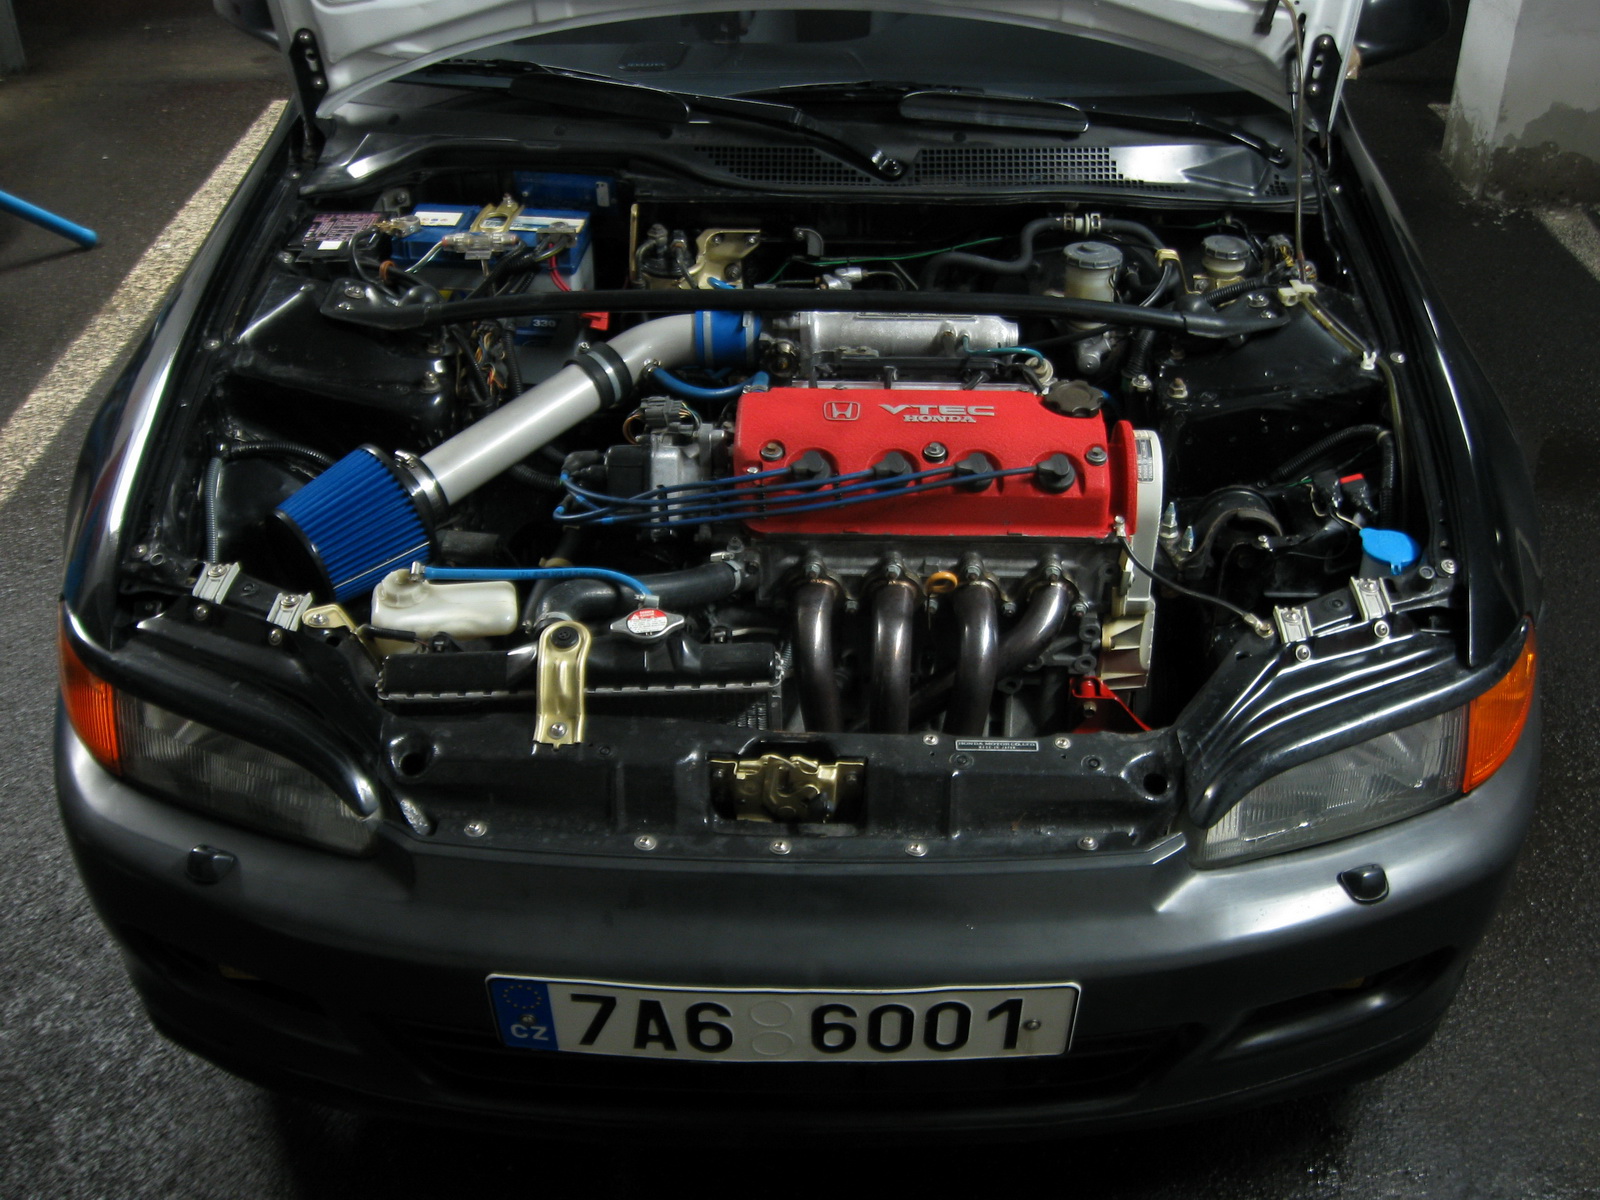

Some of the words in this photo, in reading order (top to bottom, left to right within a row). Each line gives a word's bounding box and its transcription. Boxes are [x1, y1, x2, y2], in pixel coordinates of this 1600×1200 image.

[879, 404, 995, 416] VTEC
[903, 415, 976, 423] HONDA
[570, 993, 733, 1053] 7A6
[811, 999, 1024, 1054] 6001
[510, 1023, 549, 1041] CZ
